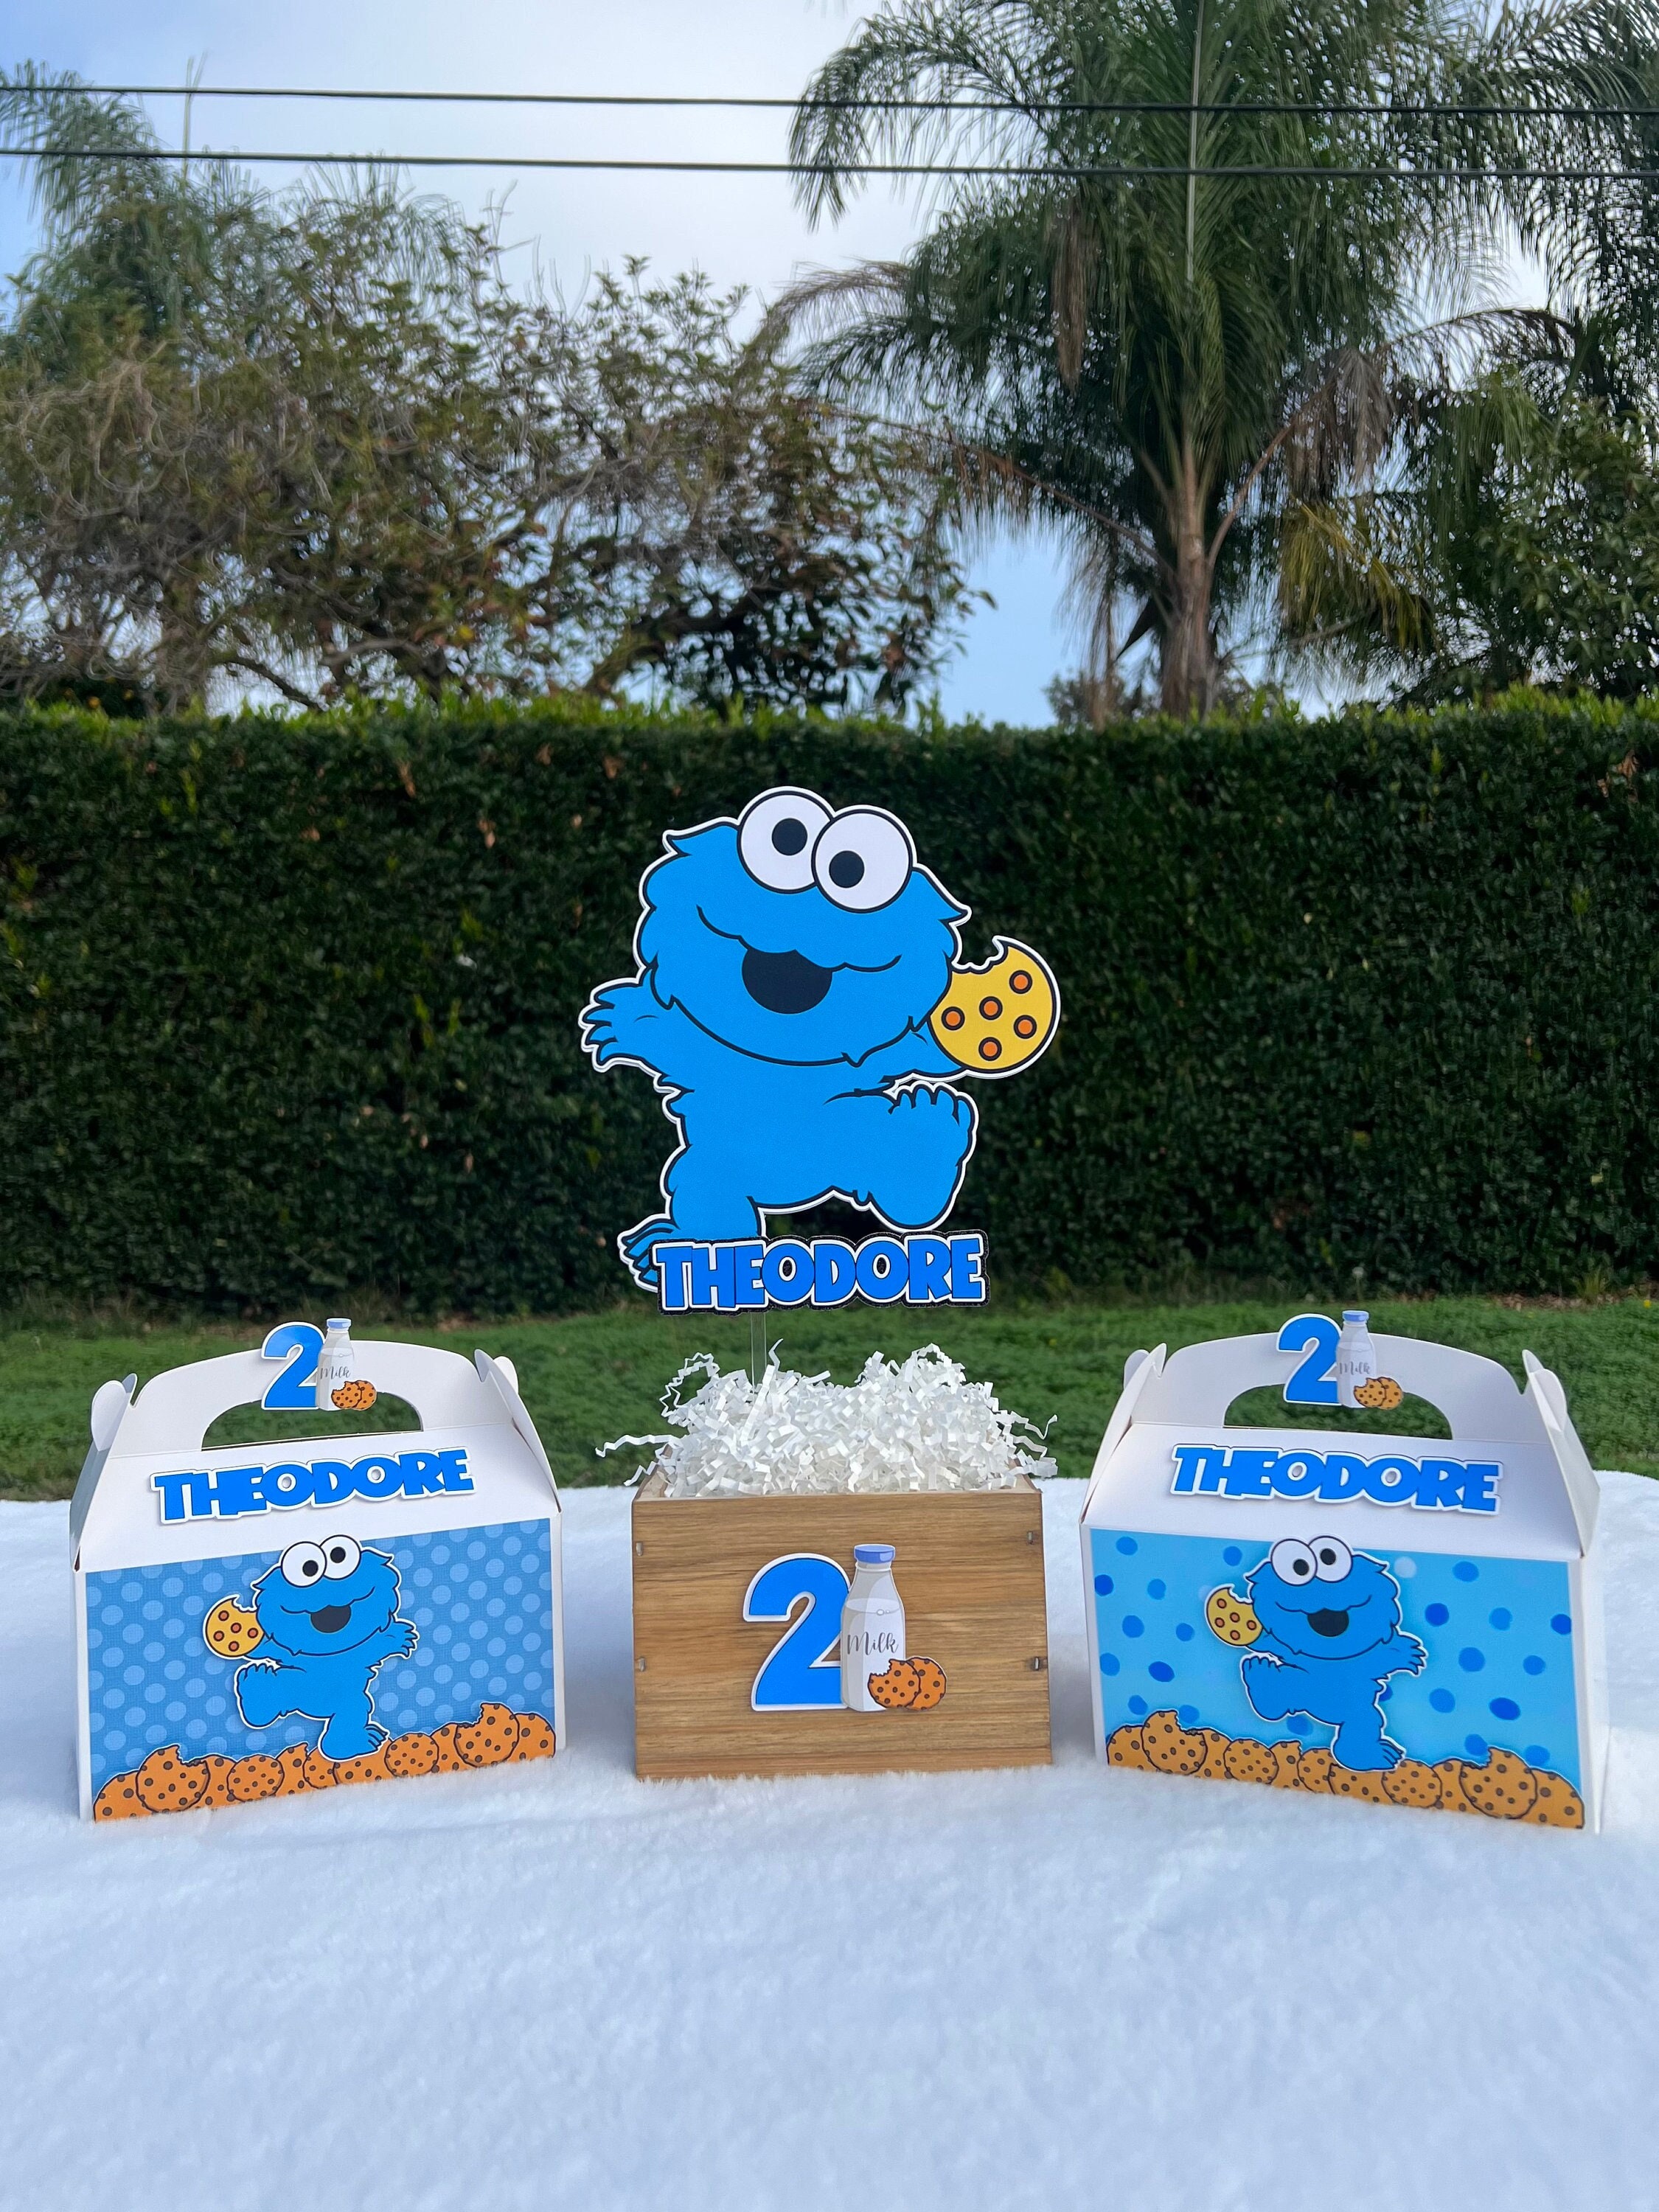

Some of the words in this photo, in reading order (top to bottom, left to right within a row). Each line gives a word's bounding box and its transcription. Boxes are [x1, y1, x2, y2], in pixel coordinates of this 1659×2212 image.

[655, 1237, 984, 1309] THEODORE
[264, 1324, 325, 1408] 2
[320, 1366, 351, 1380] Milk
[1279, 1316, 1342, 1404] 2
[1339, 1361, 1371, 1376] Milk
[154, 1448, 475, 1521] THEODORE
[1173, 1447, 1500, 1512] THEODORE
[748, 1557, 850, 1705] 2
[847, 1631, 899, 1656] Milk
